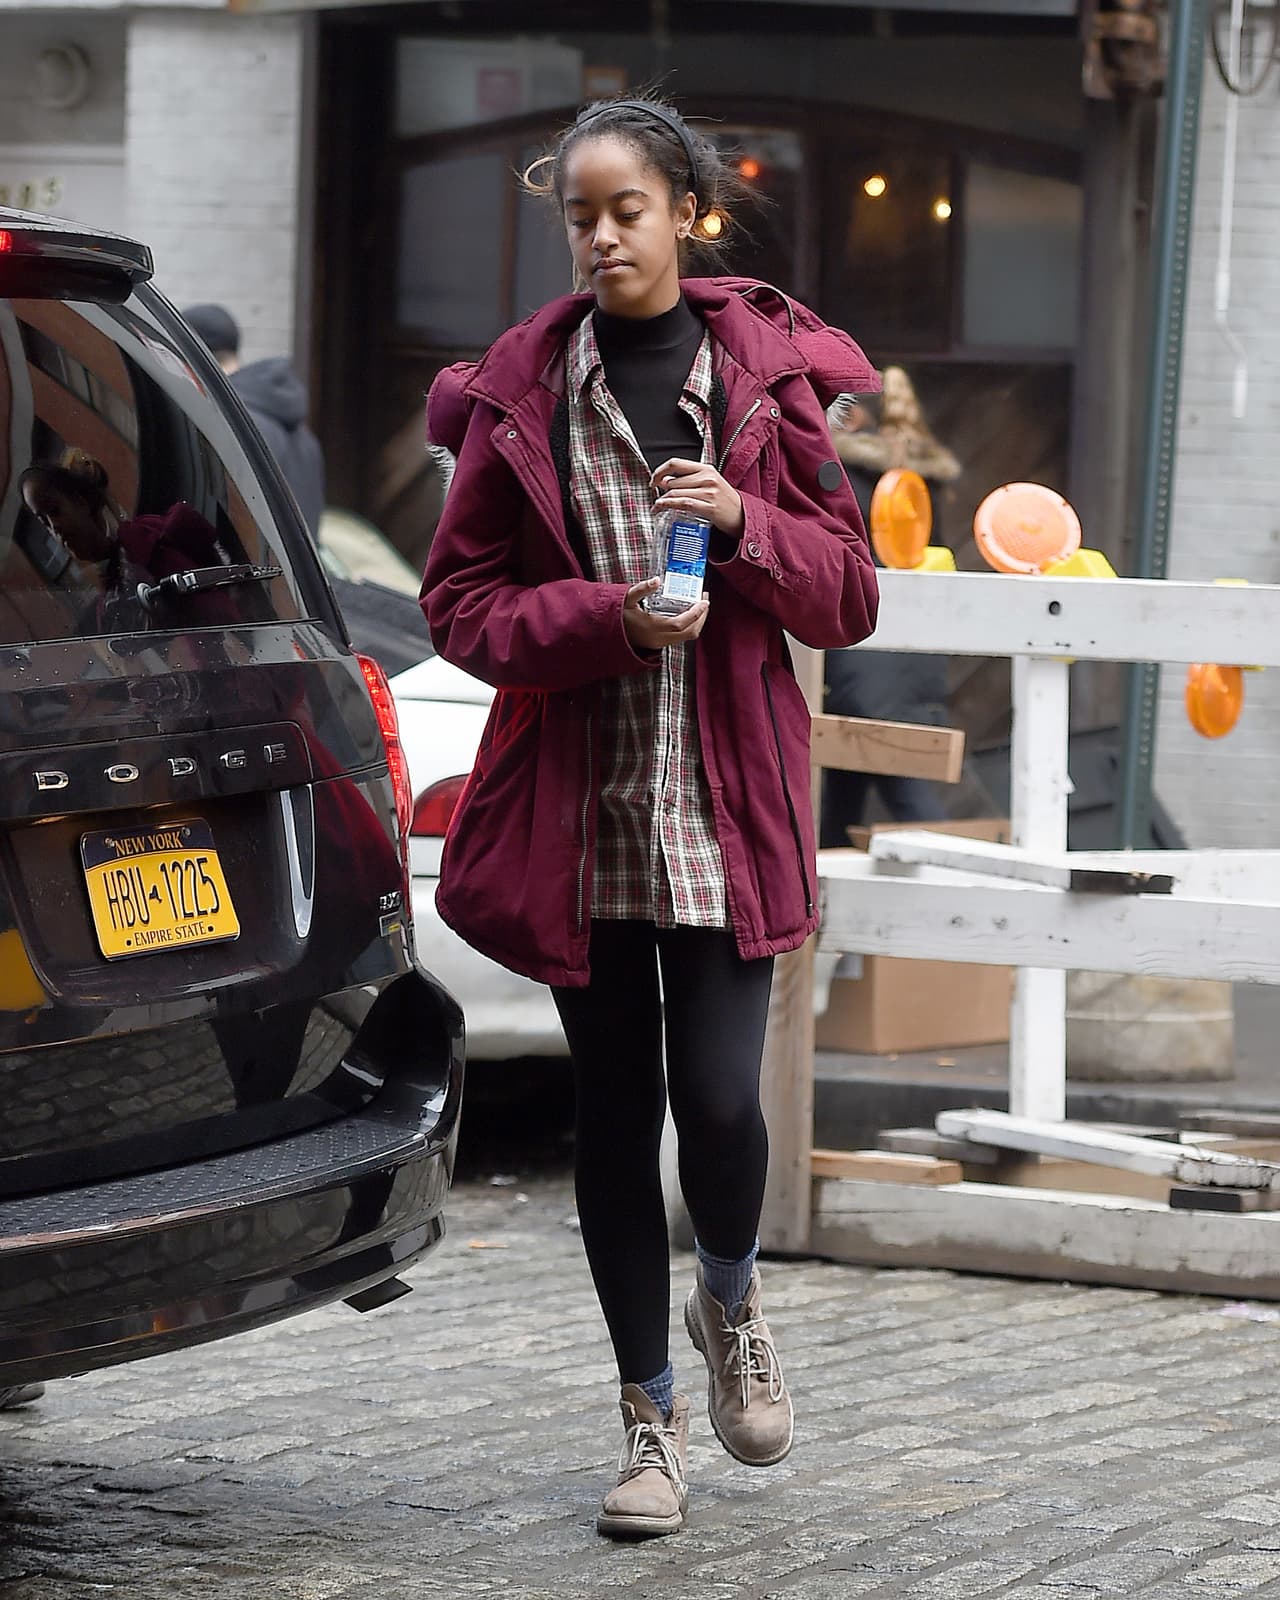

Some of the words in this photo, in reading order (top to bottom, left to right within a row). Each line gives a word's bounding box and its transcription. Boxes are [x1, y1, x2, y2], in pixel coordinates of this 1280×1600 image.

[32, 743, 286, 790] DODGE
[114, 837, 145, 857] NEW
[147, 831, 184, 850] YORK
[134, 928, 173, 946] EMPIRE
[175, 921, 206, 940] STATE
